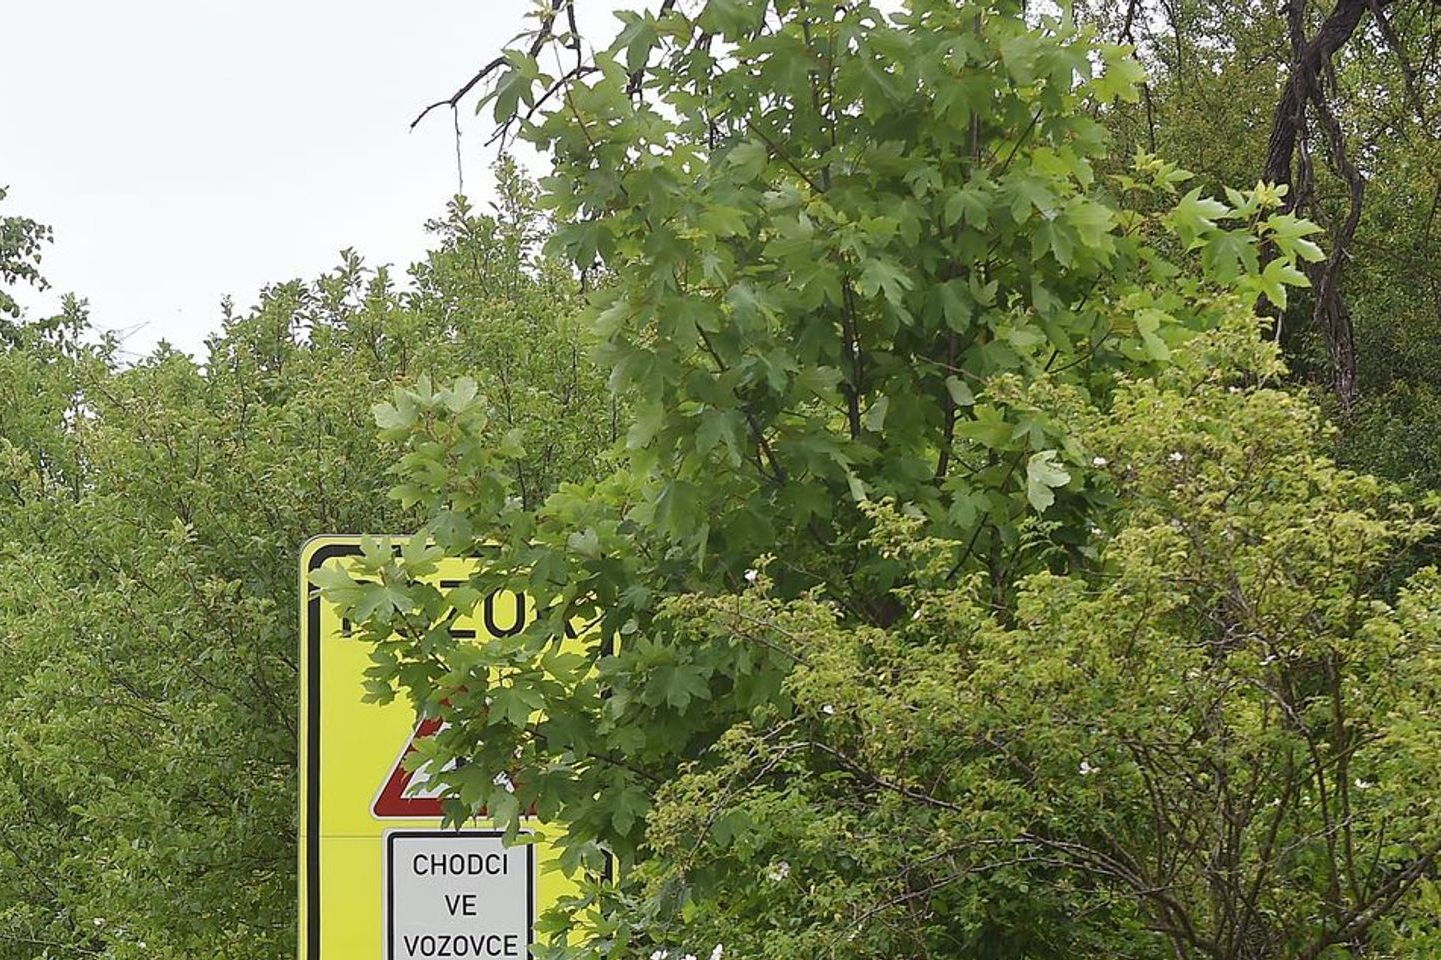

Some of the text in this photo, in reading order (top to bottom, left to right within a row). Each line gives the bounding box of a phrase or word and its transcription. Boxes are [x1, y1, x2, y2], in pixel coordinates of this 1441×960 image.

[413, 854, 508, 875] CHODCI
[445, 895, 477, 916] VE
[404, 935, 518, 956] VOZOVCE
